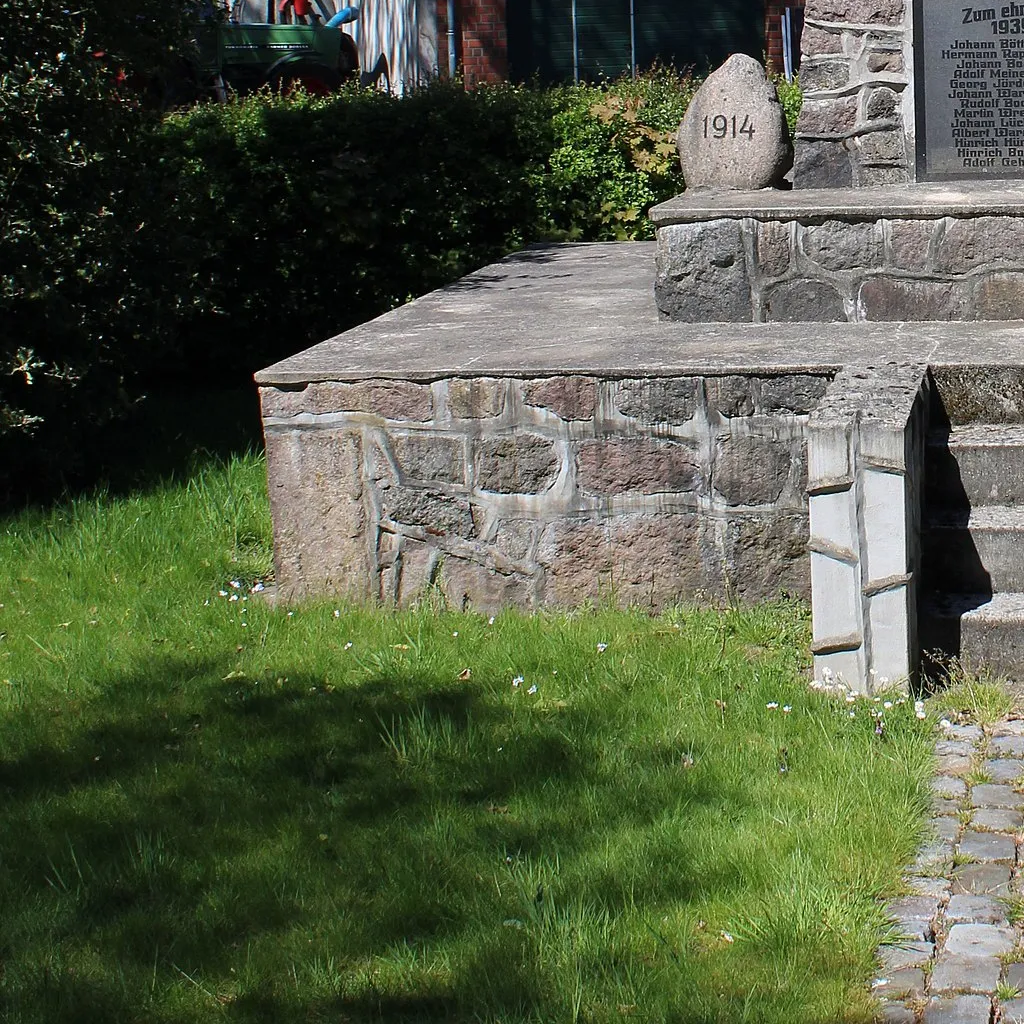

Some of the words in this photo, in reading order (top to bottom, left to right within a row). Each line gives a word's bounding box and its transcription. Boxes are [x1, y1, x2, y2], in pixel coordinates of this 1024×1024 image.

[962, 8, 996, 24] Zum
[950, 40, 995, 49] Johann
[942, 50, 997, 59] Hermann
[957, 60, 1001, 69] Johann
[953, 69, 985, 78] Adolf
[950, 79, 987, 90] Georg
[948, 89, 992, 98] Johann
[960, 99, 1000, 108] Rudolf
[954, 109, 994, 118] Martin
[703, 115, 755, 141] 1914
[951, 119, 995, 128] Johann
[952, 128, 990, 137] Albert
[955, 138, 998, 148] Hinrich
[957, 148, 1002, 157] Hinrich
[963, 158, 995, 167] Adolf
